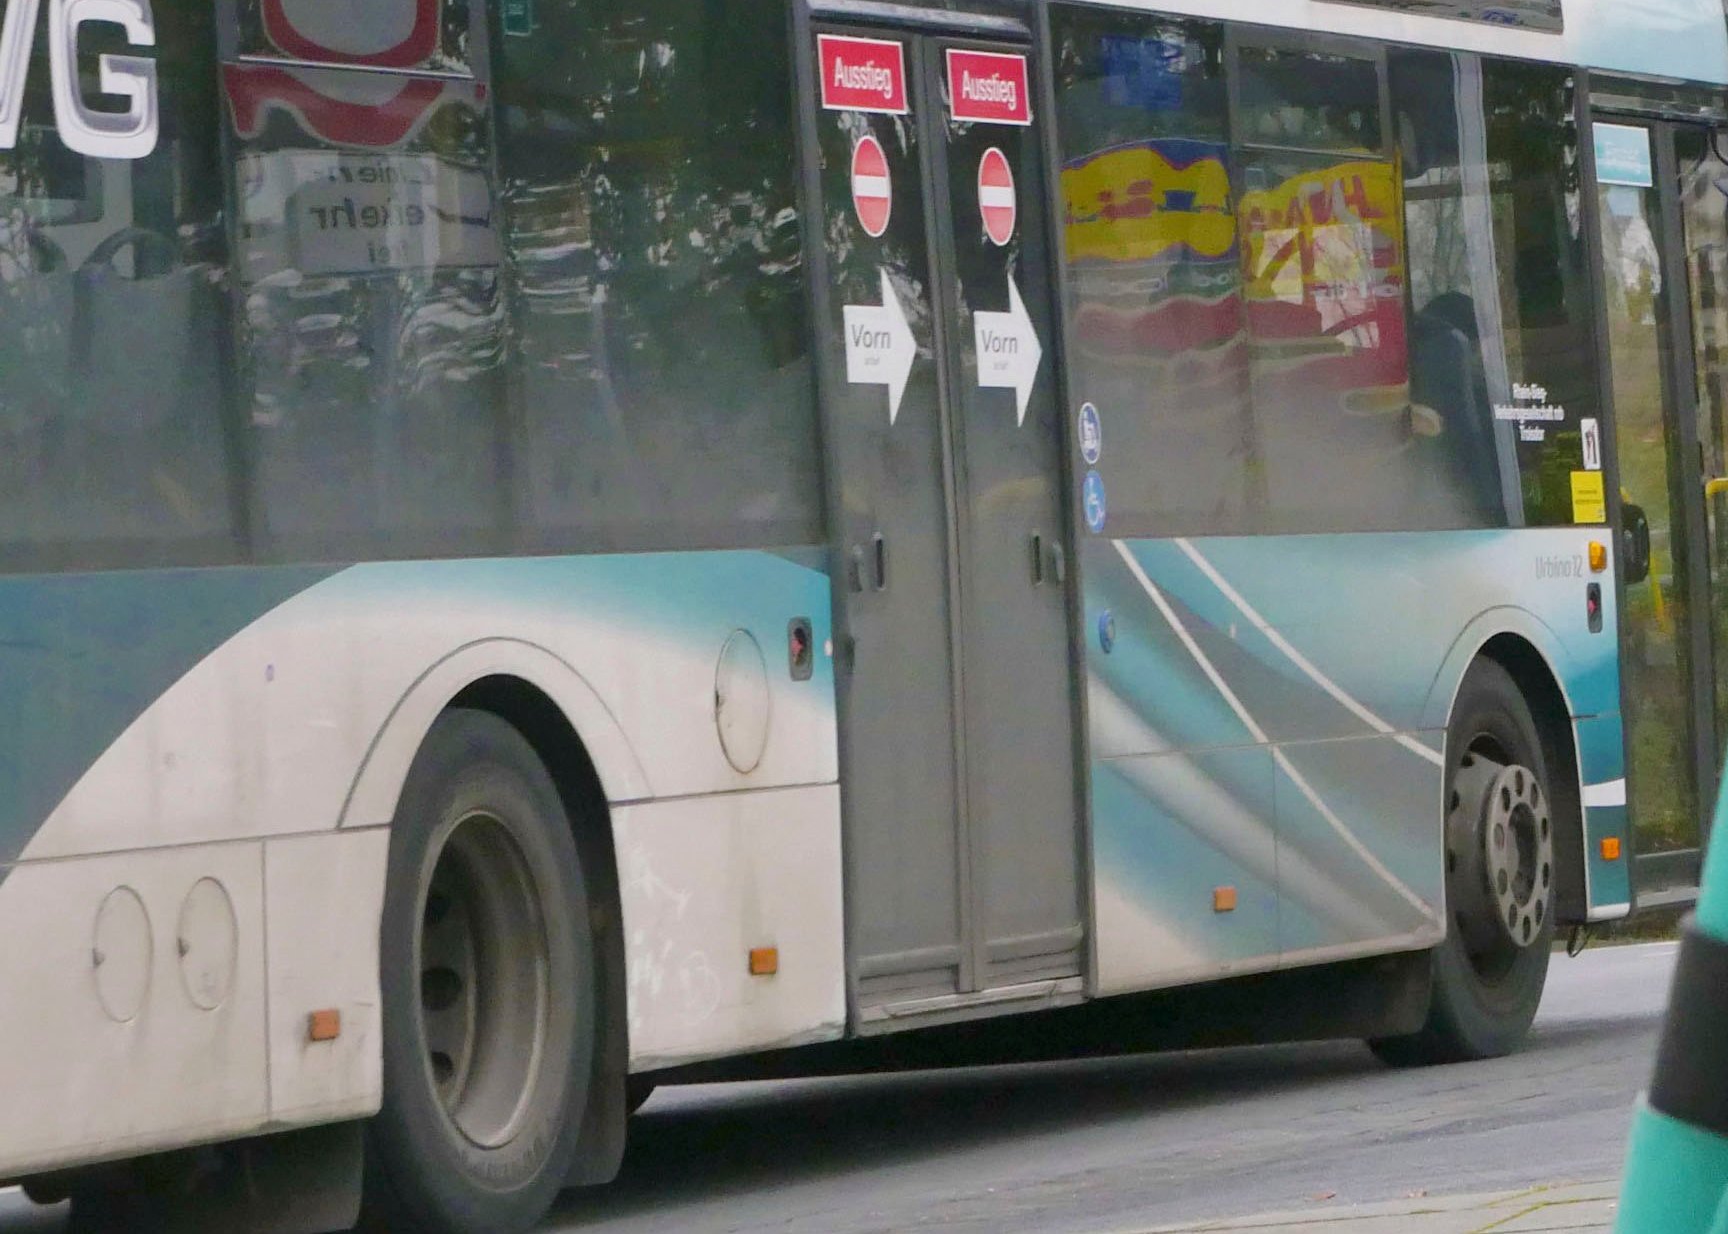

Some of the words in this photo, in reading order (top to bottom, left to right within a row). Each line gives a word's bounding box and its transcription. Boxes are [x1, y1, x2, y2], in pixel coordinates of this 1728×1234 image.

[833, 56, 894, 100] Ausstieg
[961, 70, 1017, 111] Ausstieg
[851, 324, 892, 350] Vorn
[981, 328, 1019, 354] Vorn
